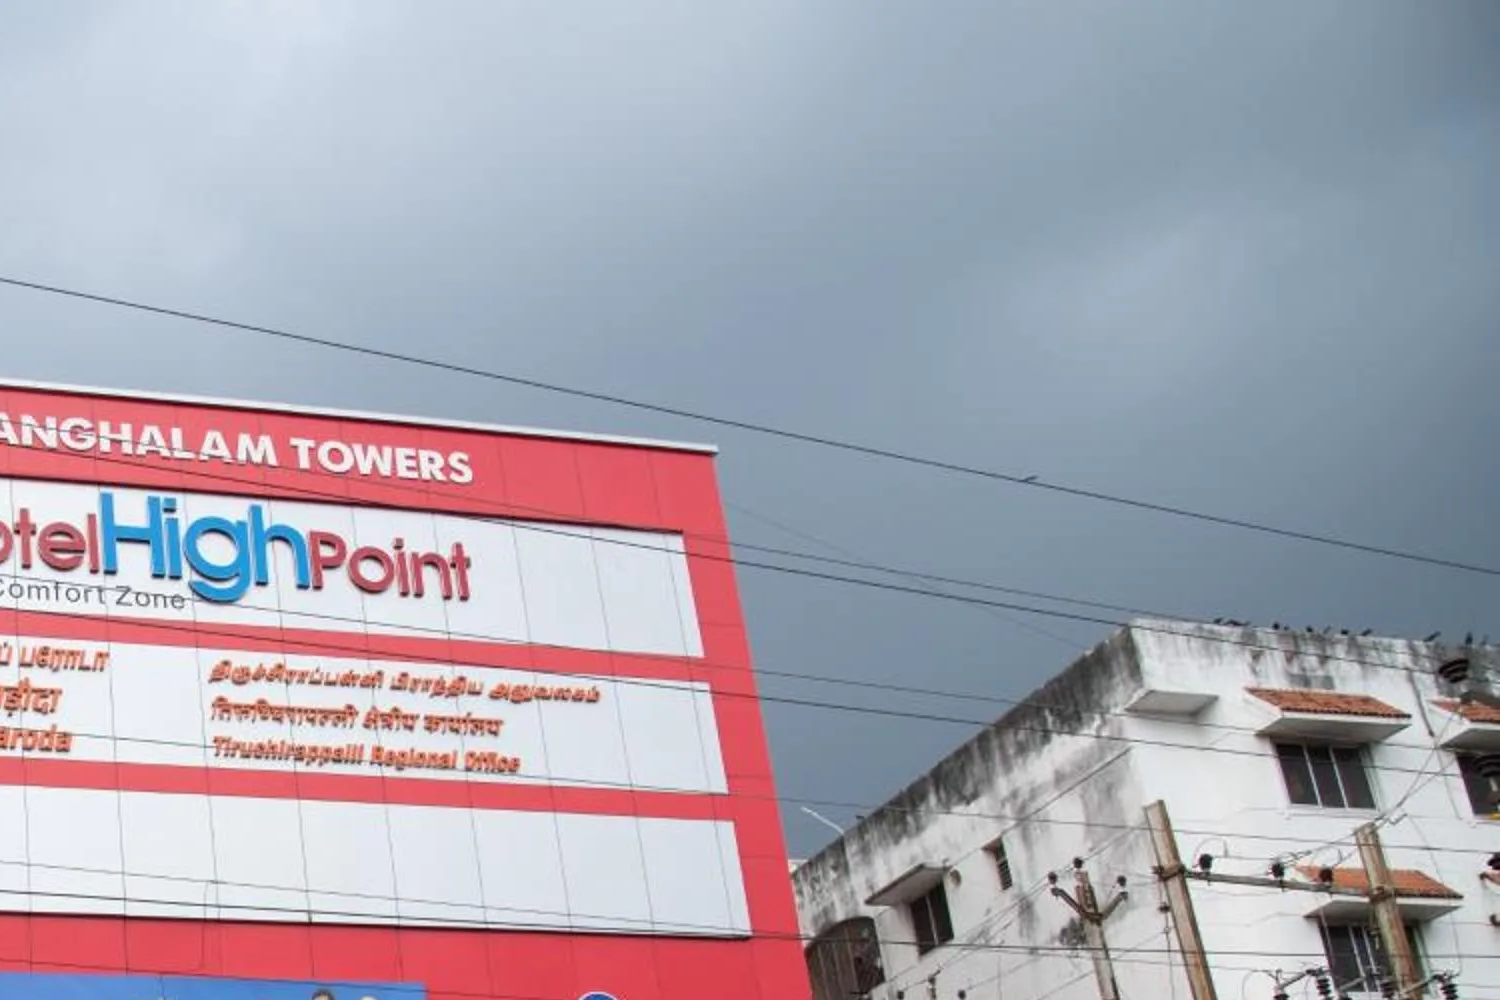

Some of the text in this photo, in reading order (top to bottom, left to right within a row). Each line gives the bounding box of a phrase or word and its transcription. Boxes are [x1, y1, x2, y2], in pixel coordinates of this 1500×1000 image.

[290, 437, 474, 485] TOWERS
[115, 585, 186, 610] Zone
[213, 736, 521, 773] Tiruchirappalli Regional Office
